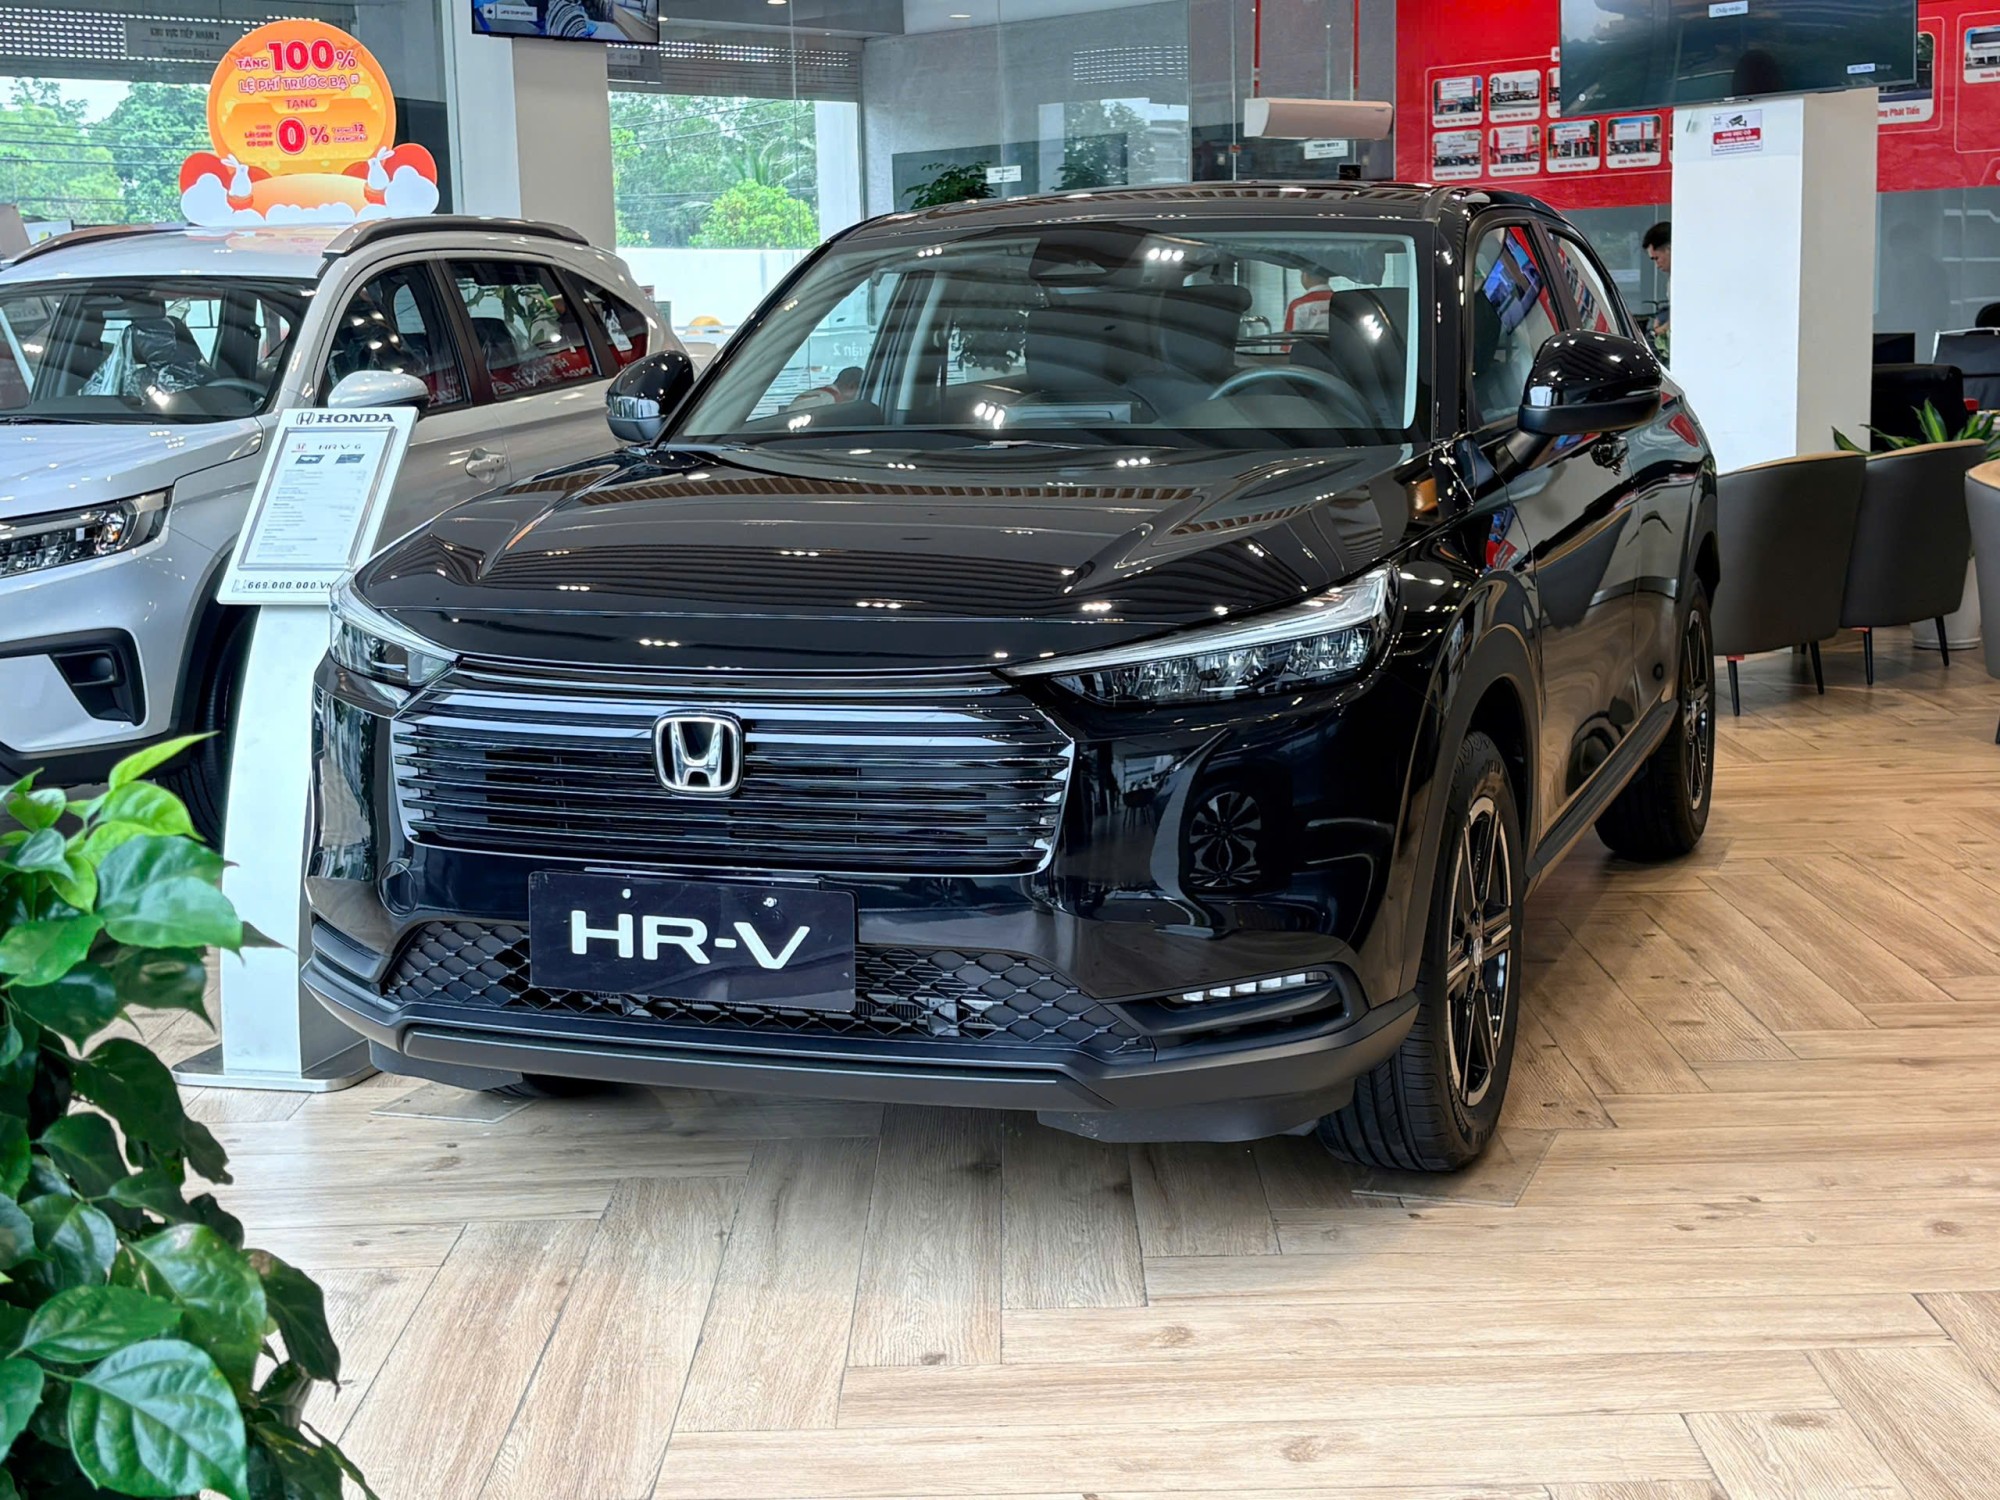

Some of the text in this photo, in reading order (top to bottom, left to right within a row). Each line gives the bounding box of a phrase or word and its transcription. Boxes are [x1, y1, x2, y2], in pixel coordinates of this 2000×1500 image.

[240, 78, 256, 93] LỆ
[258, 75, 280, 91] PHÍ
[283, 74, 327, 90] TRƯỚC
[330, 77, 349, 90] BẠ
[354, 124, 364, 132] 12
[316, 413, 394, 423] HONDA
[571, 910, 811, 970] HR-V
